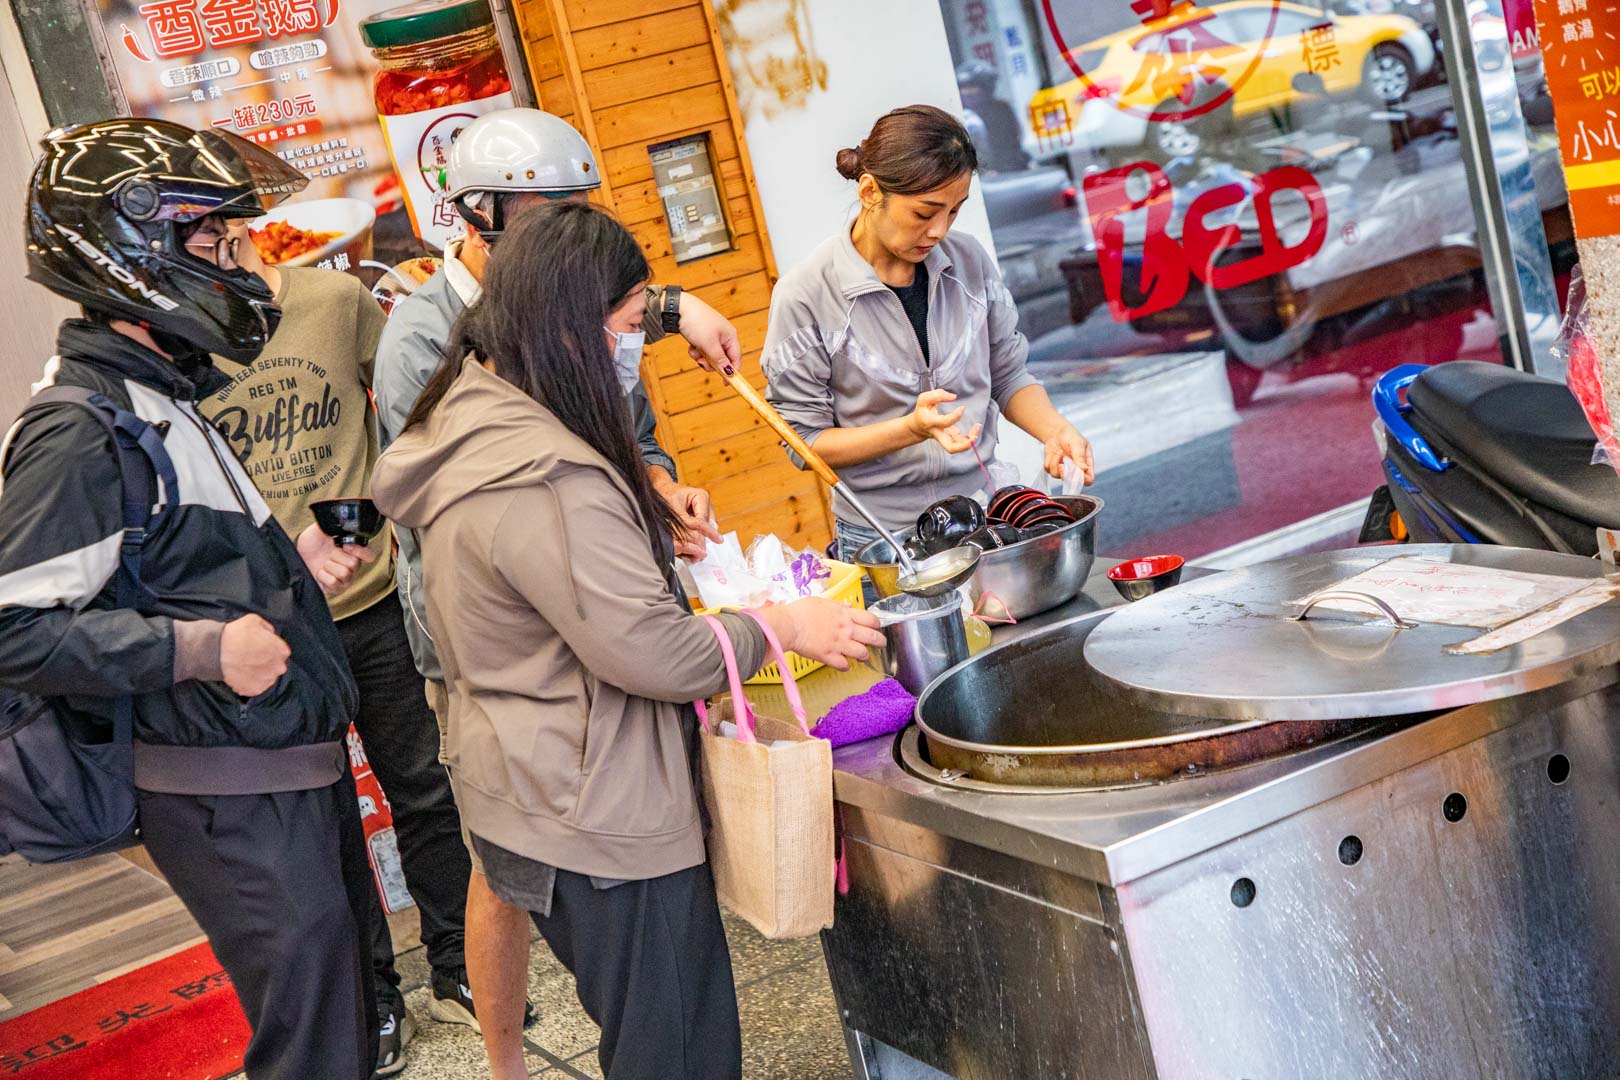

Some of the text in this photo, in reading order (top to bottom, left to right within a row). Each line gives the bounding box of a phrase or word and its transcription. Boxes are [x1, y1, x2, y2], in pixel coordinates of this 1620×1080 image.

[1562, 18, 1594, 43] 高湯
[1300, 22, 1342, 75] 標
[168, 61, 232, 86] 香辣順口
[1578, 66, 1620, 100] 可以
[212, 94, 316, 129] 一罐230元
[54, 223, 179, 311] ASTONE
[216, 357, 326, 403] NINETEEN SEVENTY TWO
[249, 376, 297, 399] REG TM
[211, 382, 341, 464] Buffalo
[290, 444, 332, 466] BITTON
[272, 464, 315, 482] LIVE FREE
[259, 489, 289, 500] EMIUM
